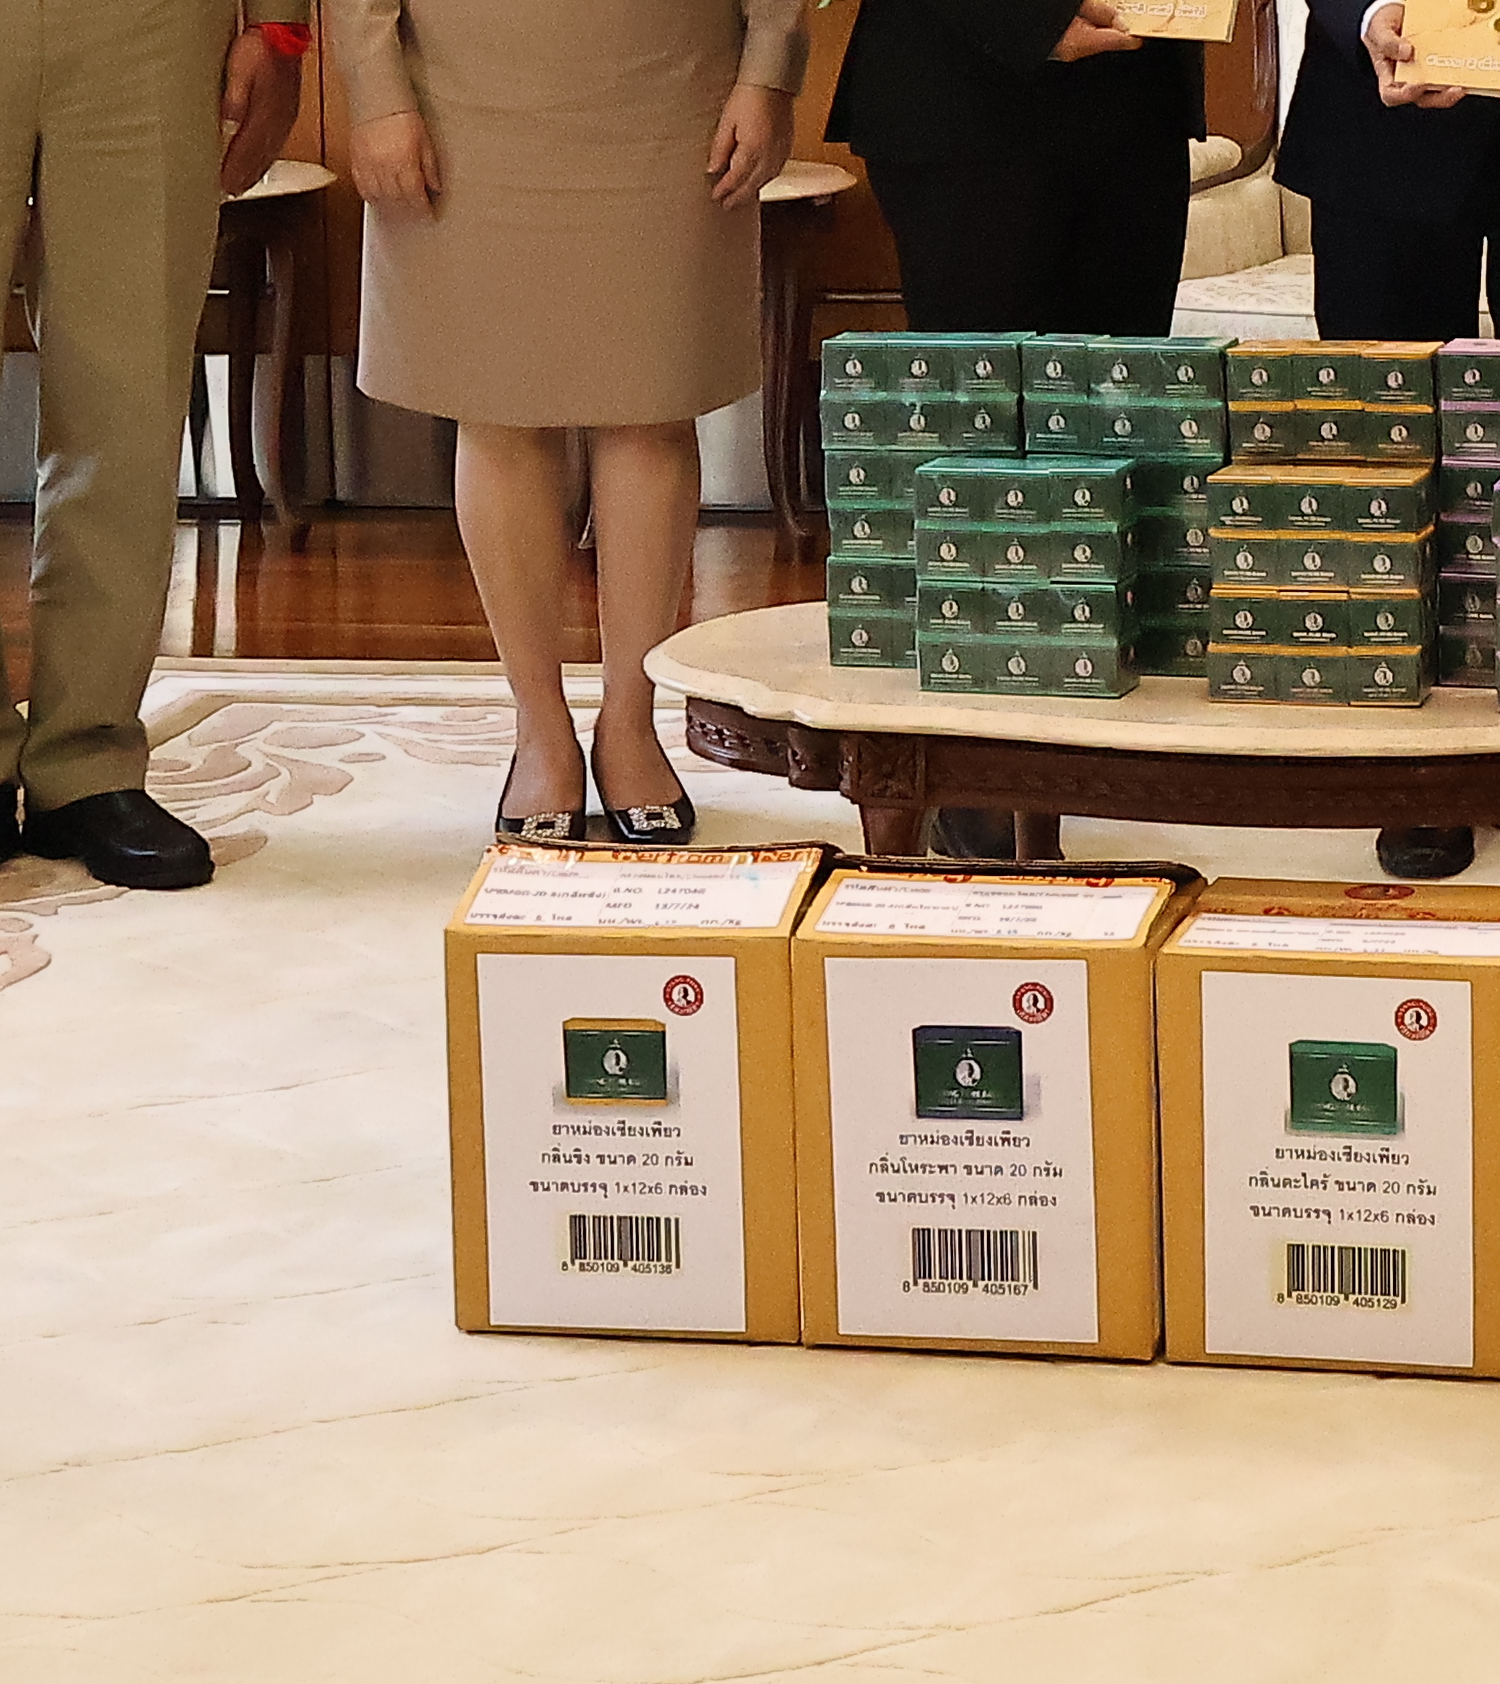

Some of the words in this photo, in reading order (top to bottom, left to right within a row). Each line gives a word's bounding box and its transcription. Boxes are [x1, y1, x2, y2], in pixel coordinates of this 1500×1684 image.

[596, 1154, 637, 1166] ขนาด
[641, 1153, 659, 1166] 20
[664, 1150, 694, 1167] กรัม
[963, 1165, 1004, 1177] ขนาด
[1009, 1163, 1027, 1177] 20
[1033, 1161, 1063, 1178] กรัม
[529, 1181, 609, 1199] ขนาดบรรจุ
[614, 1182, 663, 1195] 1x12x6
[668, 1181, 707, 1197] กล่อง
[1334, 1180, 1377, 1193] ขนาด
[1382, 1180, 1400, 1194] 20
[1406, 1179, 1437, 1196] กรัม
[875, 1191, 956, 1210] ขนาดบรรจุ
[963, 1192, 1012, 1206] 1x12x6
[1018, 1191, 1057, 1207] กล่อง
[1249, 1204, 1332, 1224] ขนาดบรรจุ
[1339, 1208, 1389, 1223] 1x12x6
[1395, 1209, 1436, 1226] กล่อง
[561, 1261, 568, 1271] 8
[579, 1262, 620, 1273] 850109
[903, 1281, 911, 1293] 8
[922, 1282, 969, 1294] 850109
[982, 1283, 1029, 1295] 405167
[1277, 1293, 1285, 1303] 8
[1295, 1294, 1340, 1306] 850109
[1352, 1297, 1398, 1309] 405129
